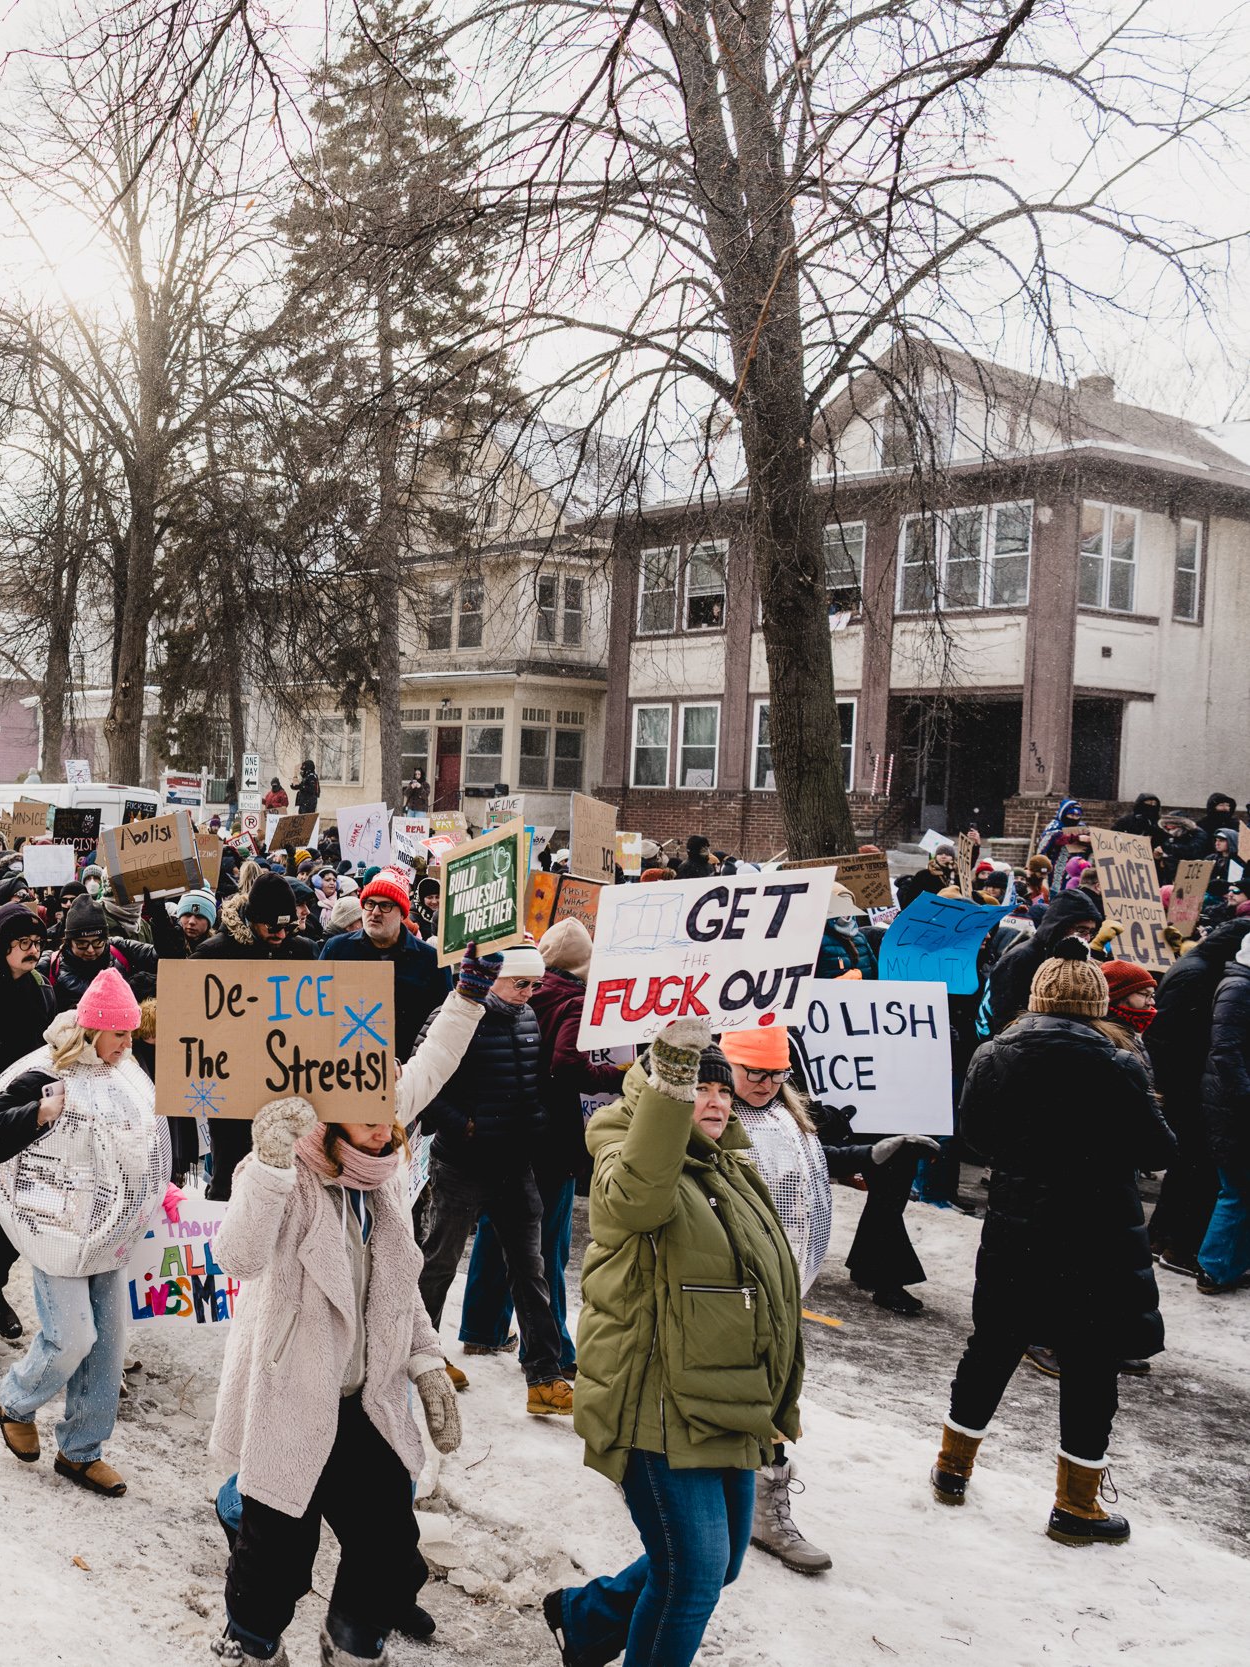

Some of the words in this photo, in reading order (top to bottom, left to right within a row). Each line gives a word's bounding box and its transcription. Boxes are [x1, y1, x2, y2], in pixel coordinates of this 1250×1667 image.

[244, 756, 257, 766] ONE
[244, 768, 258, 777] WAY
[126, 801, 143, 810] FUCK
[143, 803, 154, 811] ICE
[488, 800, 501, 811] WE
[501, 798, 520, 810] LIVE
[348, 823, 363, 848] SHAME
[405, 824, 426, 834] REAL
[435, 820, 453, 829] FAT
[53, 837, 99, 851] FASCISM
[199, 837, 210, 846] OP
[124, 847, 181, 883] ICE
[397, 850, 414, 866] MIGR
[448, 865, 477, 896] BUILD
[1098, 857, 1161, 903] INCEL
[1184, 862, 1203, 879] ICE
[452, 876, 508, 917] MINNESOTA
[564, 898, 589, 906] WHAT
[464, 898, 513, 935] TOGETHER
[685, 882, 811, 943] GET
[908, 901, 1008, 933] ICE
[1107, 902, 1163, 921] WITHOUT
[896, 926, 975, 950] LEAVE
[886, 957, 910, 981] MY
[918, 952, 970, 986] CITY
[205, 973, 335, 1022] De-ICE
[590, 972, 711, 1027] FUCK
[718, 963, 814, 1011] OUT
[801, 999, 938, 1040] OLISH
[179, 1036, 230, 1080] The
[265, 1028, 387, 1101] Streets!
[590, 1048, 616, 1065] ER
[808, 1054, 877, 1094] ICE
[582, 1099, 614, 1116] RE
[159, 1242, 225, 1278] ALL
